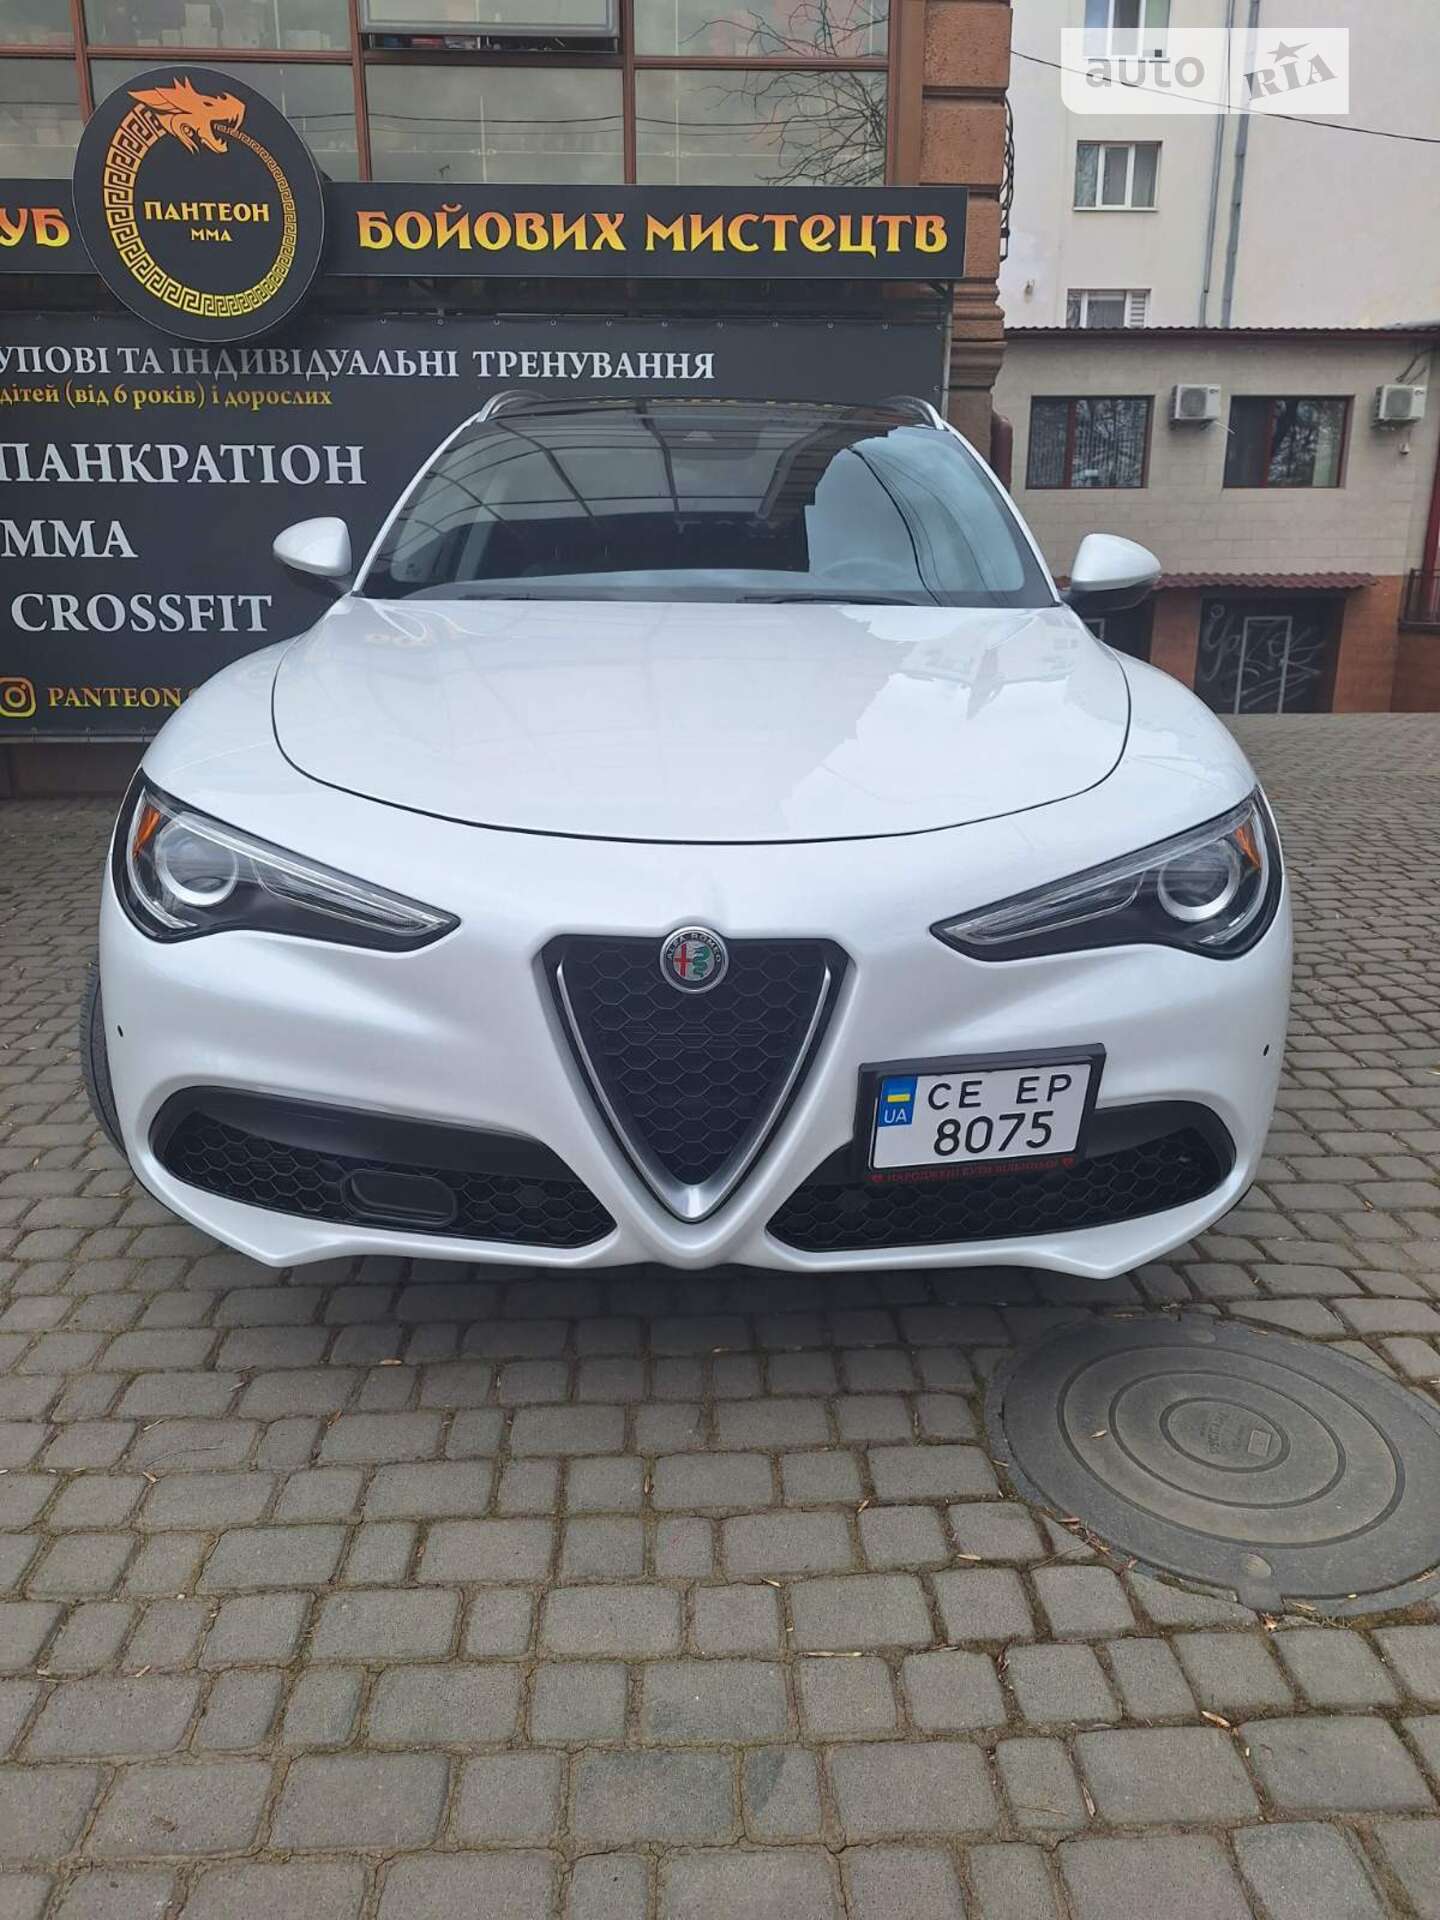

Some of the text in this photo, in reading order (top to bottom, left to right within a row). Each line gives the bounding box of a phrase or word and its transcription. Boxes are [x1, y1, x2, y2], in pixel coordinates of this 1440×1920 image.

[144, 201, 270, 222] ПАНТЕОН
[190, 228, 233, 241] ММА
[357, 203, 627, 250] БОЙОВИХ
[645, 213, 949, 258] МИСТЕЦТВ
[117, 348, 165, 374] ТА
[171, 348, 460, 382] ІНДИВІДУАЛЬНІ
[472, 351, 715, 379] ТРЕНУВАННЯ
[66, 379, 110, 408] (від
[114, 384, 128, 403] 6
[132, 380, 205, 409] років)
[211, 385, 220, 404] і
[225, 387, 333, 411] дорослих
[0, 443, 367, 485] ПАНКРАТІОН
[0, 520, 139, 558] ММА
[11, 593, 272, 632] CROSSFIT
[928, 1073, 1073, 1110] CE EP
[884, 1108, 908, 1124] UA
[933, 1110, 1054, 1157] 8075
